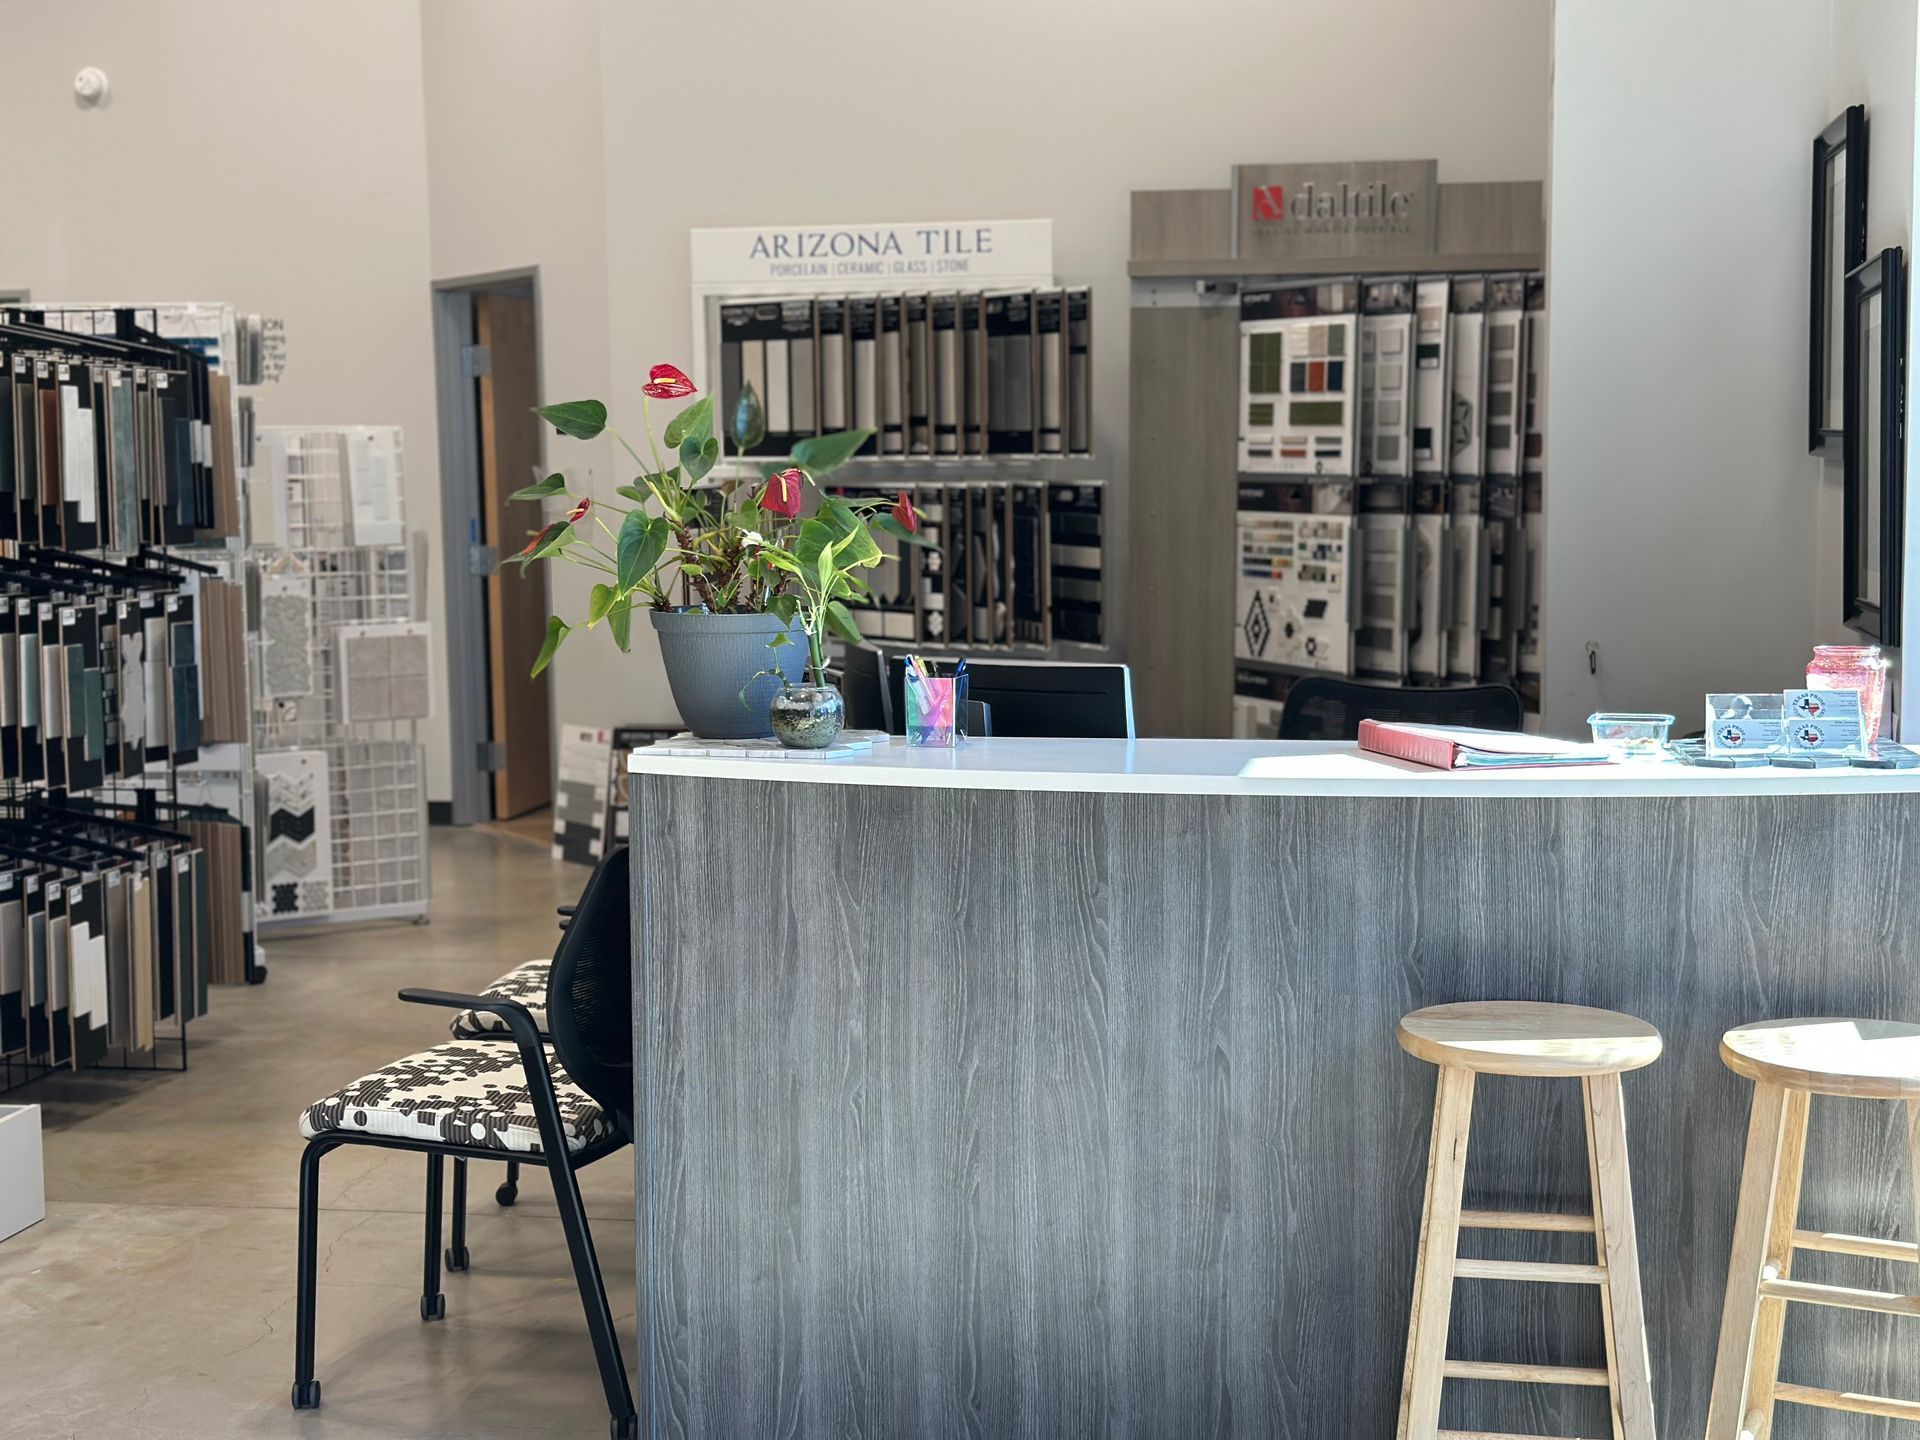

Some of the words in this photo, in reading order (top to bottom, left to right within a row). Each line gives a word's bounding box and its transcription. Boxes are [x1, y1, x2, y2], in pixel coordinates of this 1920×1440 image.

[1290, 181, 1411, 218] daltile
[749, 231, 903, 259] ARIZONA
[916, 228, 993, 255] TILE
[770, 262, 828, 277] PORCELAIN
[837, 261, 884, 275] CERAMIC
[893, 260, 928, 274] GLASS
[936, 259, 970, 273] STONE
[1792, 693, 1808, 706] TEXAS
[1810, 693, 1825, 706] PRIDE
